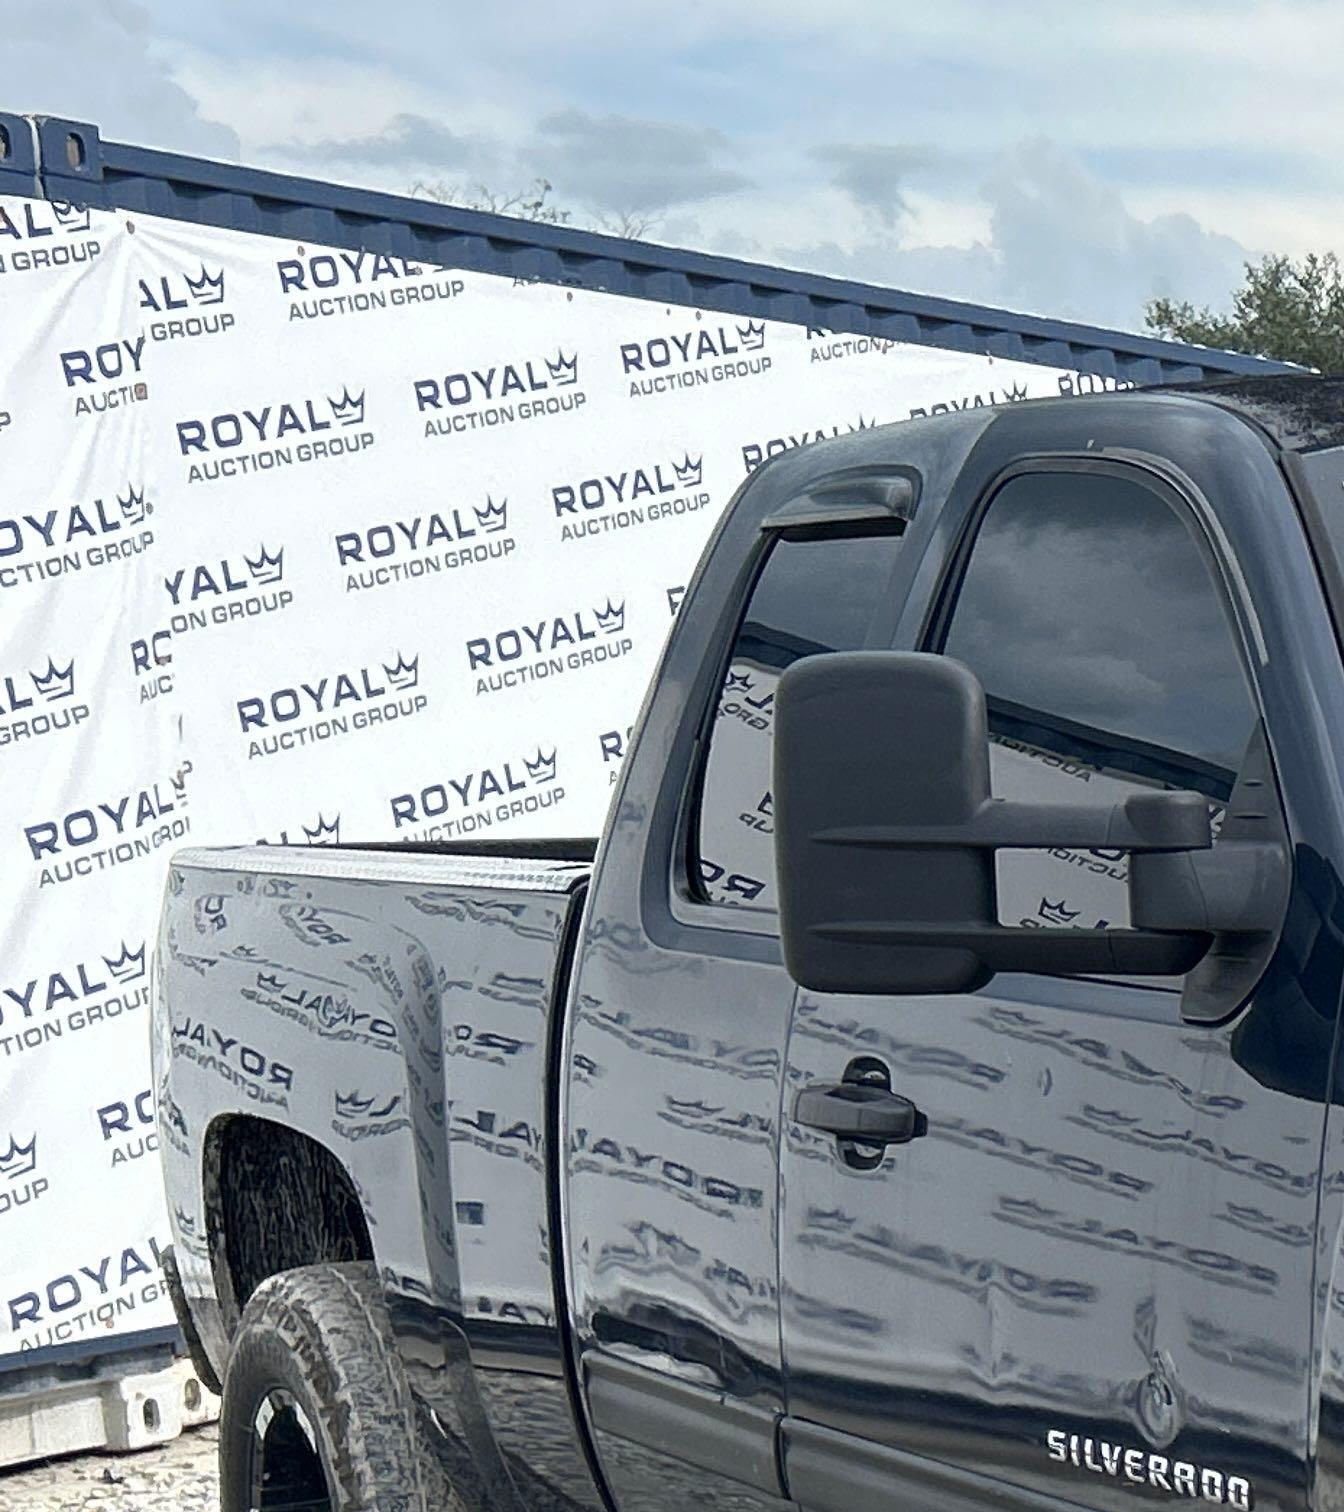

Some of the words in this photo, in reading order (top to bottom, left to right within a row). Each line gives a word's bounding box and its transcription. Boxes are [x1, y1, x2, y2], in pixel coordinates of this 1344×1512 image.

[11, 241, 101, 271] GROUP
[289, 290, 386, 321] AUCTION
[390, 280, 465, 306] GROUP
[150, 313, 235, 342] GROUP
[620, 327, 738, 374] ROYAL
[60, 336, 145, 387] ROY
[413, 361, 548, 411] ROYAL
[629, 369, 708, 397] AUCTION
[712, 356, 772, 382] GROUP
[75, 383, 148, 417] AUCTIO
[424, 404, 514, 438] AUCTION
[518, 392, 586, 420] GROUP
[176, 400, 331, 455] ROYAL
[188, 446, 292, 483] AUCTION
[296, 432, 375, 462] GROUP
[552, 465, 675, 517] ROYAL
[0, 499, 120, 558] OYAL
[335, 509, 476, 566] ROYAL
[561, 509, 644, 542] AUCTION
[647, 492, 710, 521] GROUP
[0, 551, 82, 588] CTION
[86, 530, 154, 566] GROUP
[164, 560, 247, 605] YAL
[346, 555, 441, 592] AUCTION
[445, 538, 515, 569] GROUP
[211, 590, 293, 625] GROUP
[466, 612, 596, 671] ROYAL
[476, 656, 564, 696] AUCTION
[568, 638, 633, 669] GROUP
[237, 668, 386, 733] ROYAL
[248, 715, 348, 760] AUCTION
[352, 694, 428, 730] GROUP
[390, 763, 526, 828] ROYAL
[496, 786, 566, 821] GROUP
[24, 783, 174, 860] ROYAL
[39, 836, 152, 888] AUCTION
[3, 963, 107, 1018] YAL
[0, 1018, 62, 1056] TION
[1047, 1429, 1250, 1512] SILVERADO
